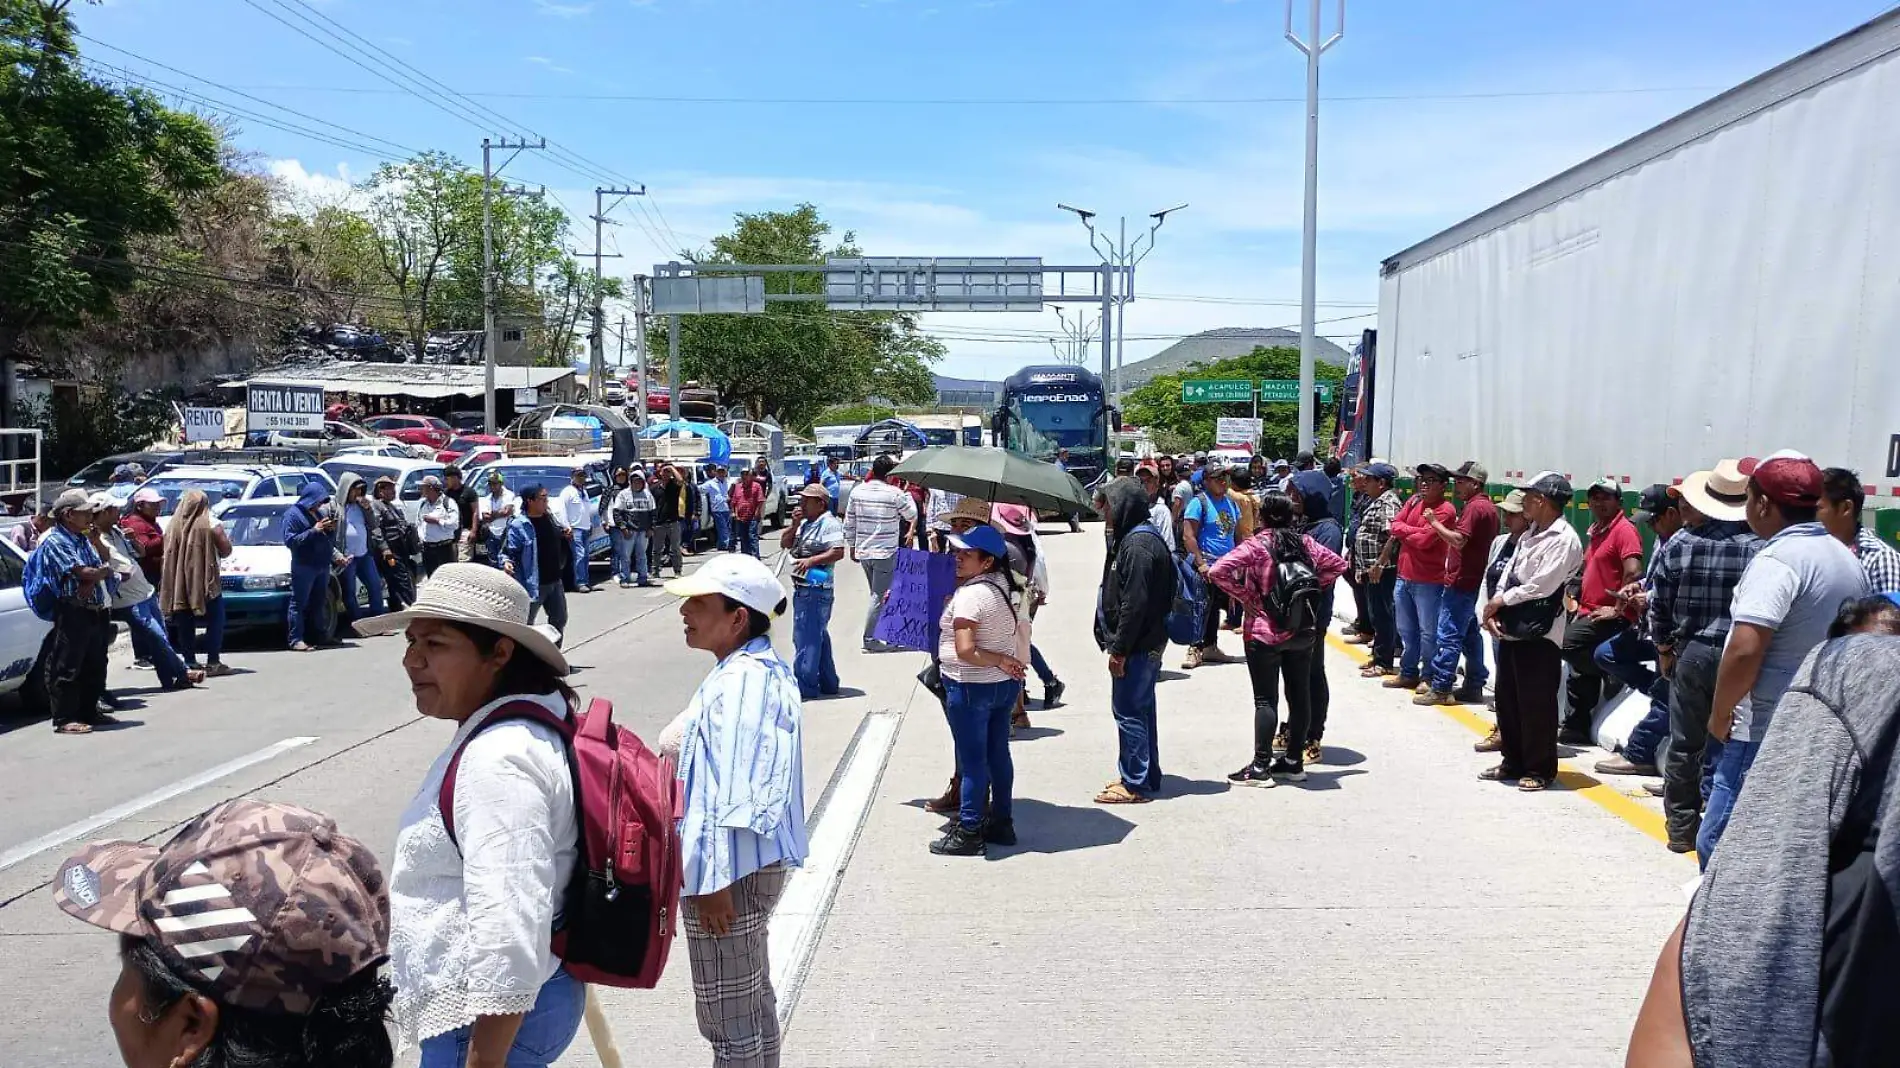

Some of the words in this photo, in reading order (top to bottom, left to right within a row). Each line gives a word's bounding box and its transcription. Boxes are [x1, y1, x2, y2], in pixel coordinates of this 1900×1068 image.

[251, 389, 282, 412] RENTA
[285, 388, 291, 411] Ó
[293, 391, 321, 412] VENTA
[187, 409, 223, 426] RENTO
